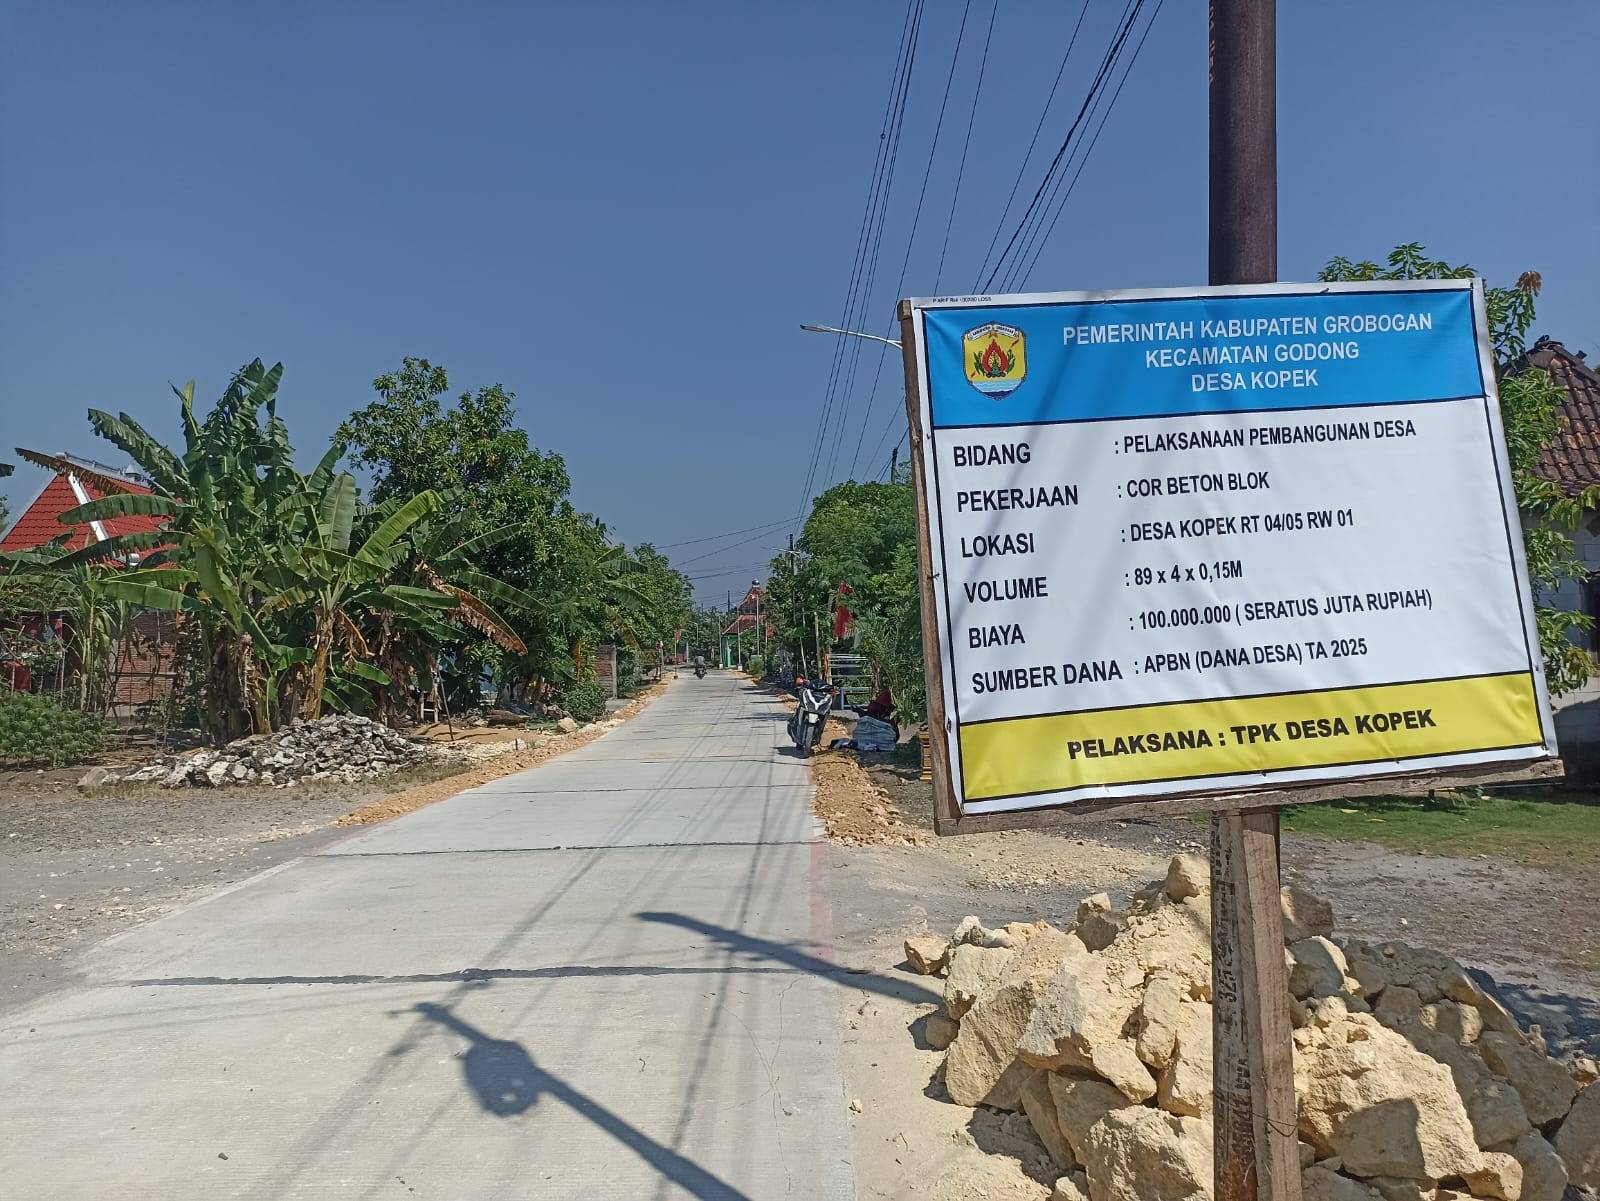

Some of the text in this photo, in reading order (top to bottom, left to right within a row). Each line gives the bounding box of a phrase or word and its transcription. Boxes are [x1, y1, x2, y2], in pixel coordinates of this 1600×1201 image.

[1064, 313, 1432, 345] PEMERINTAH KABUPATEN GROBOGAN
[1146, 342, 1359, 369] KECAMATAN GODONG
[1192, 369, 1318, 392] DESA KOPEK
[954, 443, 1030, 466] BIDANG
[1124, 429, 1243, 453] PELAKSANAAN
[1250, 422, 1369, 445] PEMBANGUNAN
[1374, 420, 1416, 438] DESA
[958, 485, 1078, 512] PEKERJAAN
[1127, 479, 1163, 497] COR
[1167, 474, 1223, 494] BETON
[1228, 472, 1269, 490] BLOK
[961, 533, 1034, 557] LOKASI
[1131, 522, 1176, 541] DESA
[1180, 517, 1237, 537] KOPEK
[1241, 516, 1259, 533] RT
[1265, 513, 1303, 532] 04/05
[1307, 511, 1332, 529] RW
[1337, 509, 1353, 526] 01
[964, 577, 1048, 603] VOLUME
[1135, 568, 1152, 585] 89
[1157, 571, 1166, 583] x
[1171, 565, 1180, 582] 4
[1185, 568, 1195, 581] x
[1199, 560, 1242, 582] 0,15M
[969, 624, 1025, 648] BIAYA
[1140, 605, 1230, 629] 100.000.000
[1245, 598, 1318, 620] SERATUS
[1324, 595, 1364, 614] JUTA
[1366, 589, 1431, 610] RUPIAH)
[973, 666, 1058, 694] SUMBER
[1063, 660, 1122, 684] DANA
[1145, 653, 1190, 673] APBN
[1196, 648, 1249, 673] (DANA
[1254, 643, 1302, 665] DESA)
[1305, 642, 1328, 659] TA
[1331, 638, 1367, 657] 2025
[1067, 730, 1213, 759] PELAKSANA
[1230, 723, 1281, 744] TPK
[1286, 718, 1349, 739] DESA
[1355, 709, 1436, 734] KOPEK
